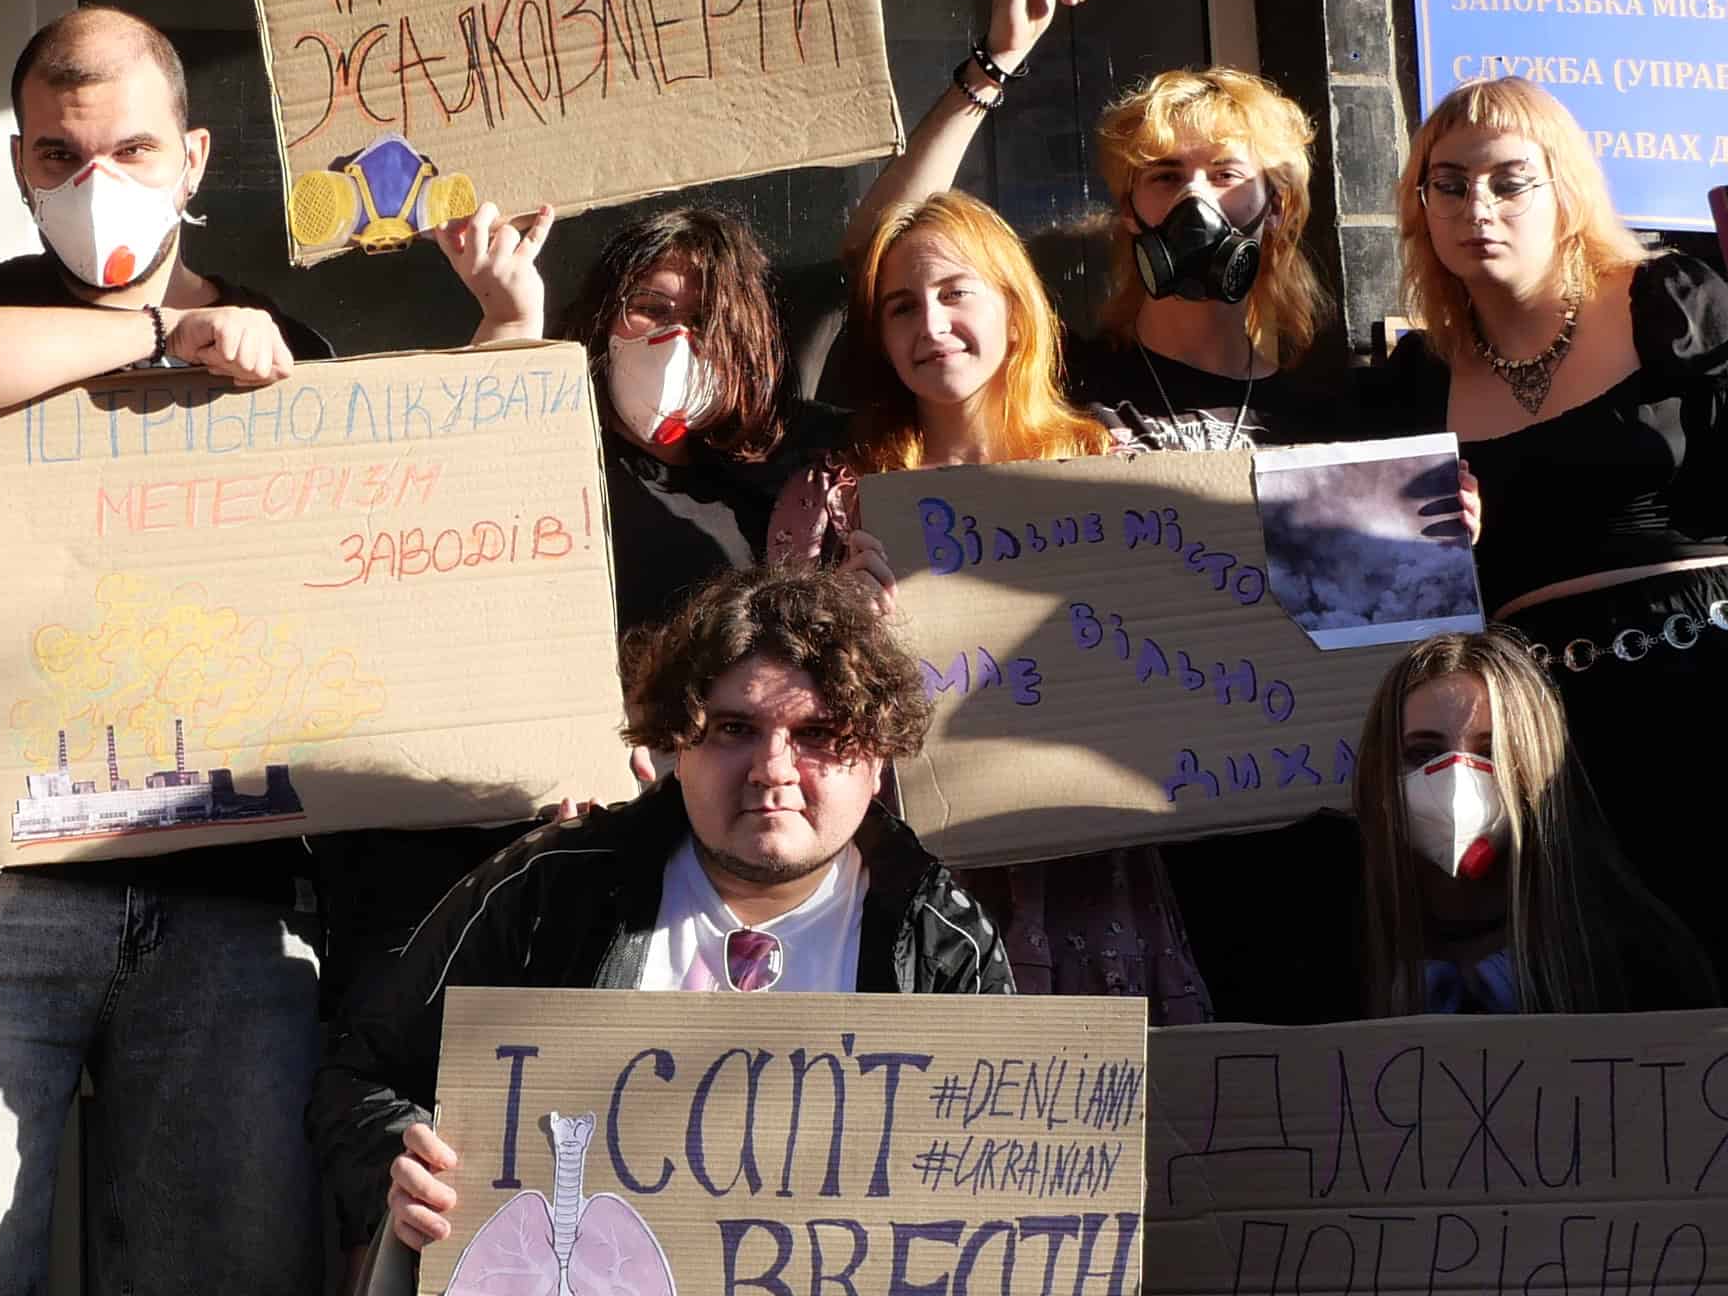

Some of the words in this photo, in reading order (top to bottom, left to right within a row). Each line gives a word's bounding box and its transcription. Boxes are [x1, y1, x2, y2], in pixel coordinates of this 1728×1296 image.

[1453, 55, 1603, 86] СЛУЖБА
[346, 368, 585, 445] ЛІКУВАТИ
[492, 1044, 540, 1190] I
